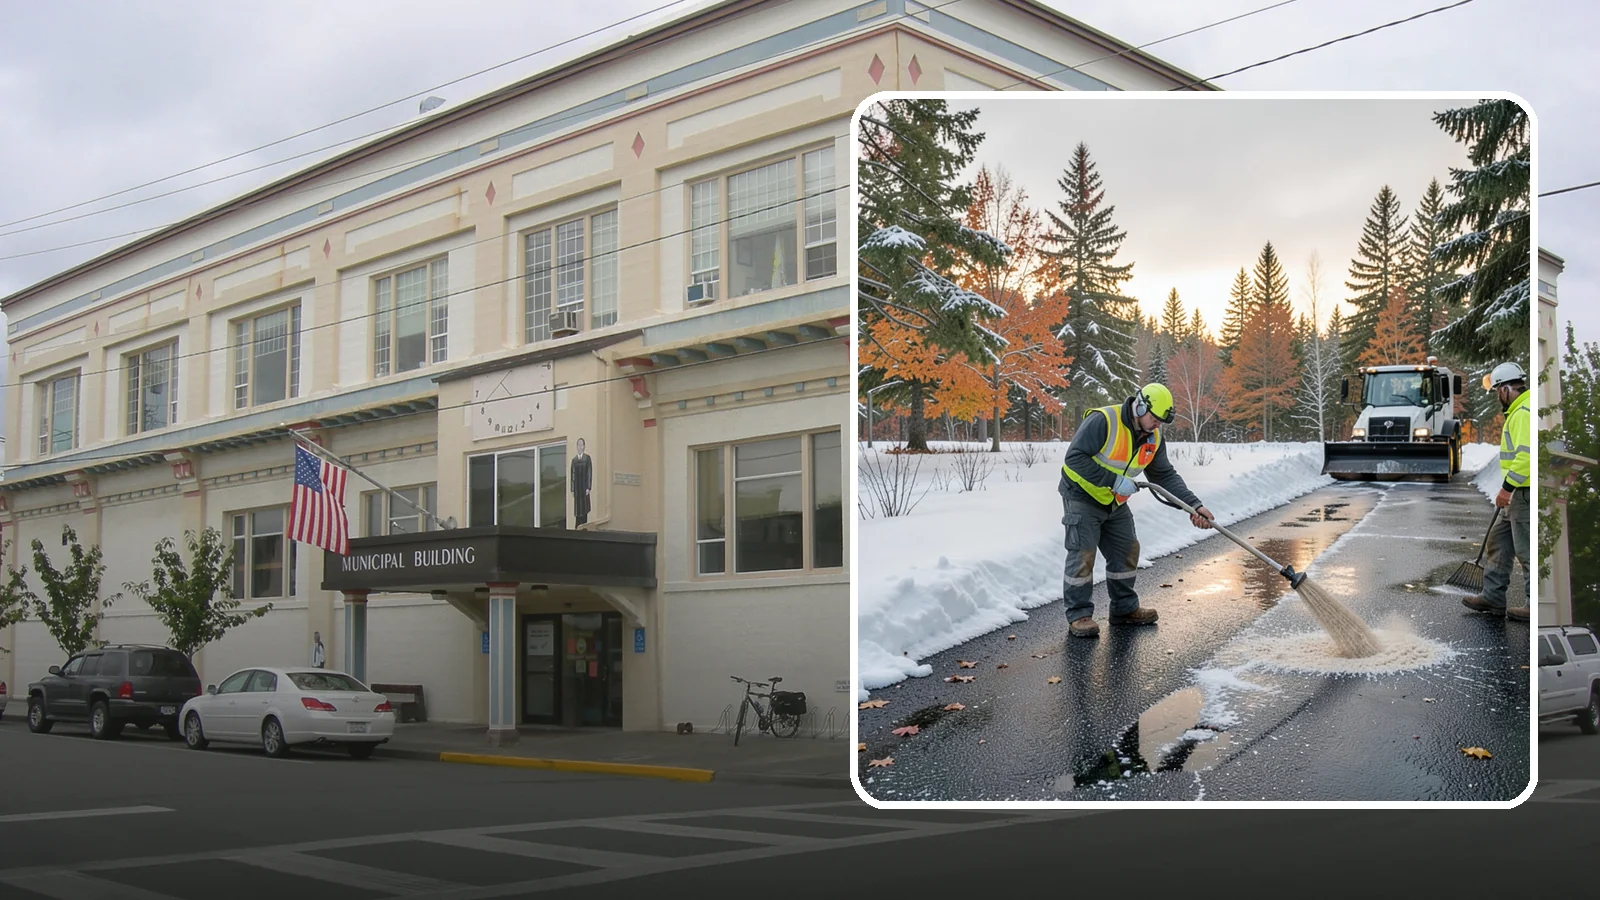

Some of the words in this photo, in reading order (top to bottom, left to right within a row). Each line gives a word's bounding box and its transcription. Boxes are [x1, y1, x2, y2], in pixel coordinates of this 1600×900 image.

[475, 390, 479, 398] 7
[536, 402, 540, 410] 4
[480, 407, 485, 415] 8
[488, 417, 492, 426] 9
[529, 414, 533, 422] 3
[521, 420, 526, 428] 2
[494, 424, 500, 432] 10
[502, 426, 506, 434] 11
[508, 425, 514, 433] 12
[342, 552, 405, 572] MUNICIPAL
[414, 546, 475, 567] BUILDING
